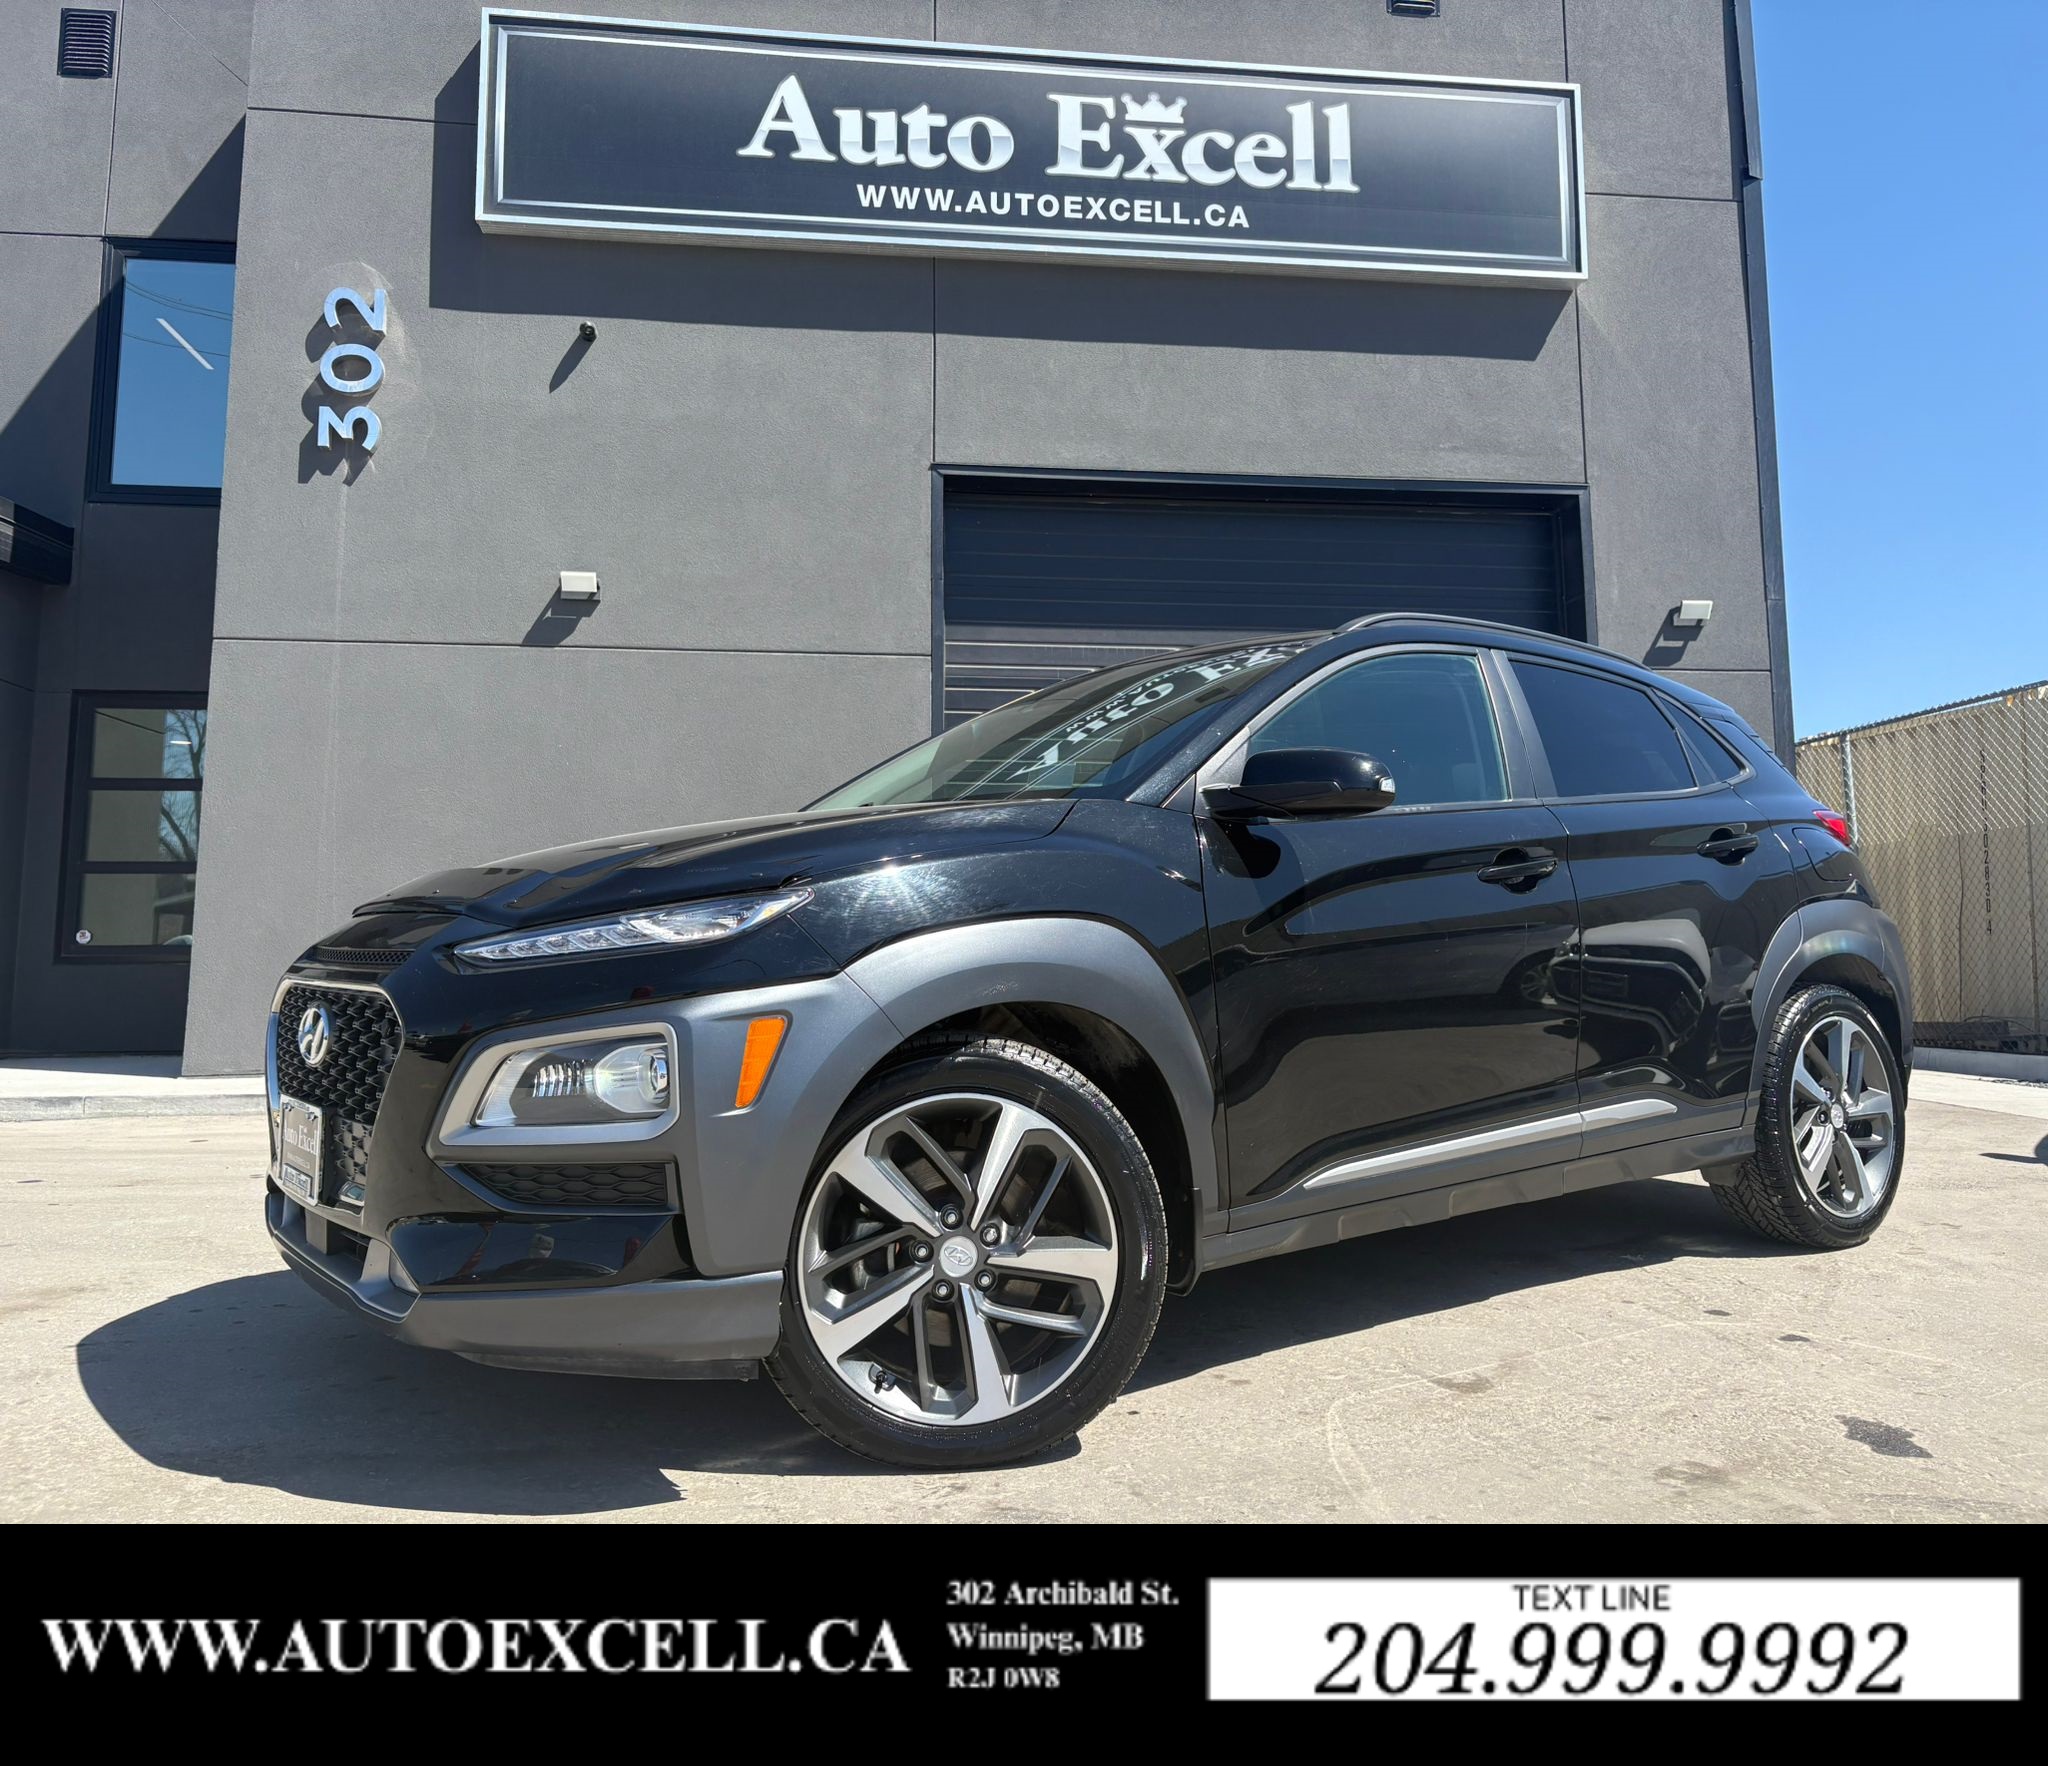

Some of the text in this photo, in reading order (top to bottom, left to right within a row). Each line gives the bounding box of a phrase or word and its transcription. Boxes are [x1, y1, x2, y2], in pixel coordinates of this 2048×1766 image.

[735, 73, 1361, 193] Auto Excell
[856, 183, 1250, 229] WWW.AUTOEXCELL.CA
[317, 286, 388, 452] 302
